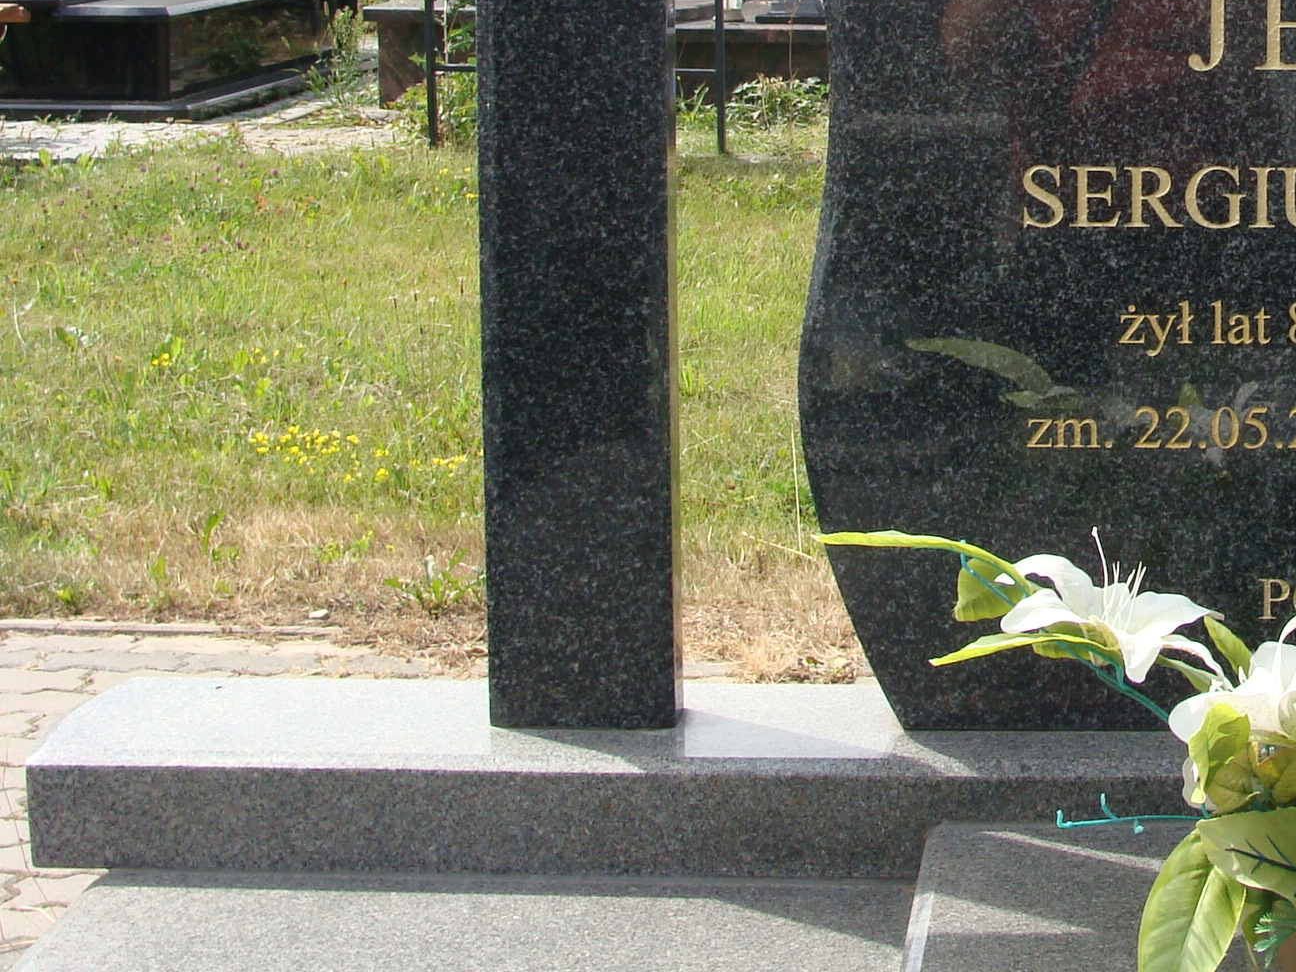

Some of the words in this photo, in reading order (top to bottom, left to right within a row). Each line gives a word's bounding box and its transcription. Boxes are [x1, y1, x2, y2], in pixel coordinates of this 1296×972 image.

[1118, 300, 1194, 357] żył
[1210, 300, 1271, 346] lat
[1026, 416, 1114, 451] zm.
